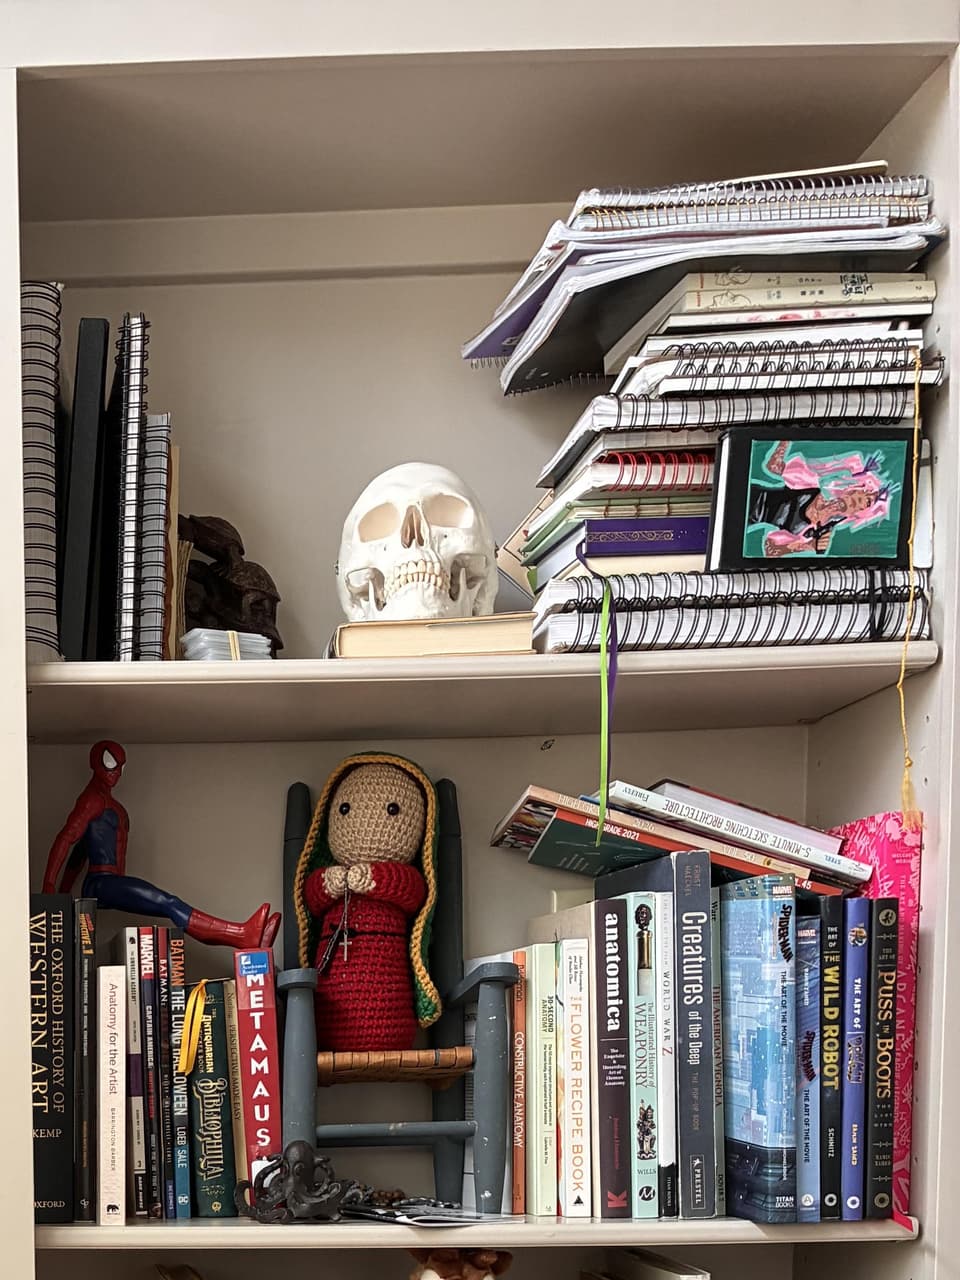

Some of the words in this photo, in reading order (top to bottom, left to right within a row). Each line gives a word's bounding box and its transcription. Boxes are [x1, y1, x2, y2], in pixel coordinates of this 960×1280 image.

[661, 799, 724, 831] ARCHITECTURE
[724, 816, 769, 844] SKETCHING
[51, 911, 63, 943] THE
[140, 935, 154, 976] MARVEL
[605, 912, 620, 1032] anatomica
[683, 912, 707, 1004] Creatures
[824, 954, 840, 962] THE
[51, 948, 63, 1015] OXFORD
[823, 967, 839, 1021] WILD
[878, 970, 896, 1022] PUSS
[107, 983, 118, 1029] Anatomy
[688, 1011, 701, 1020] of
[52, 1021, 64, 1087] HISTORY
[109, 1032, 119, 1046] for
[570, 1004, 582, 1071] FLOWER
[634, 1002, 647, 1087] WEAPONRY
[687, 1042, 702, 1064] Deep
[689, 1024, 702, 1038] the
[109, 1049, 119, 1065] the
[246, 974, 272, 1146] METAMAUS
[823, 1027, 839, 1089] ROBOT
[877, 1037, 895, 1098] BOOTS
[53, 1092, 64, 1113] OF
[109, 1068, 119, 1094] Artist
[571, 1078, 583, 1137] RECIPE
[32, 1129, 62, 1137] KEMP
[572, 1144, 583, 1192] BOOK
